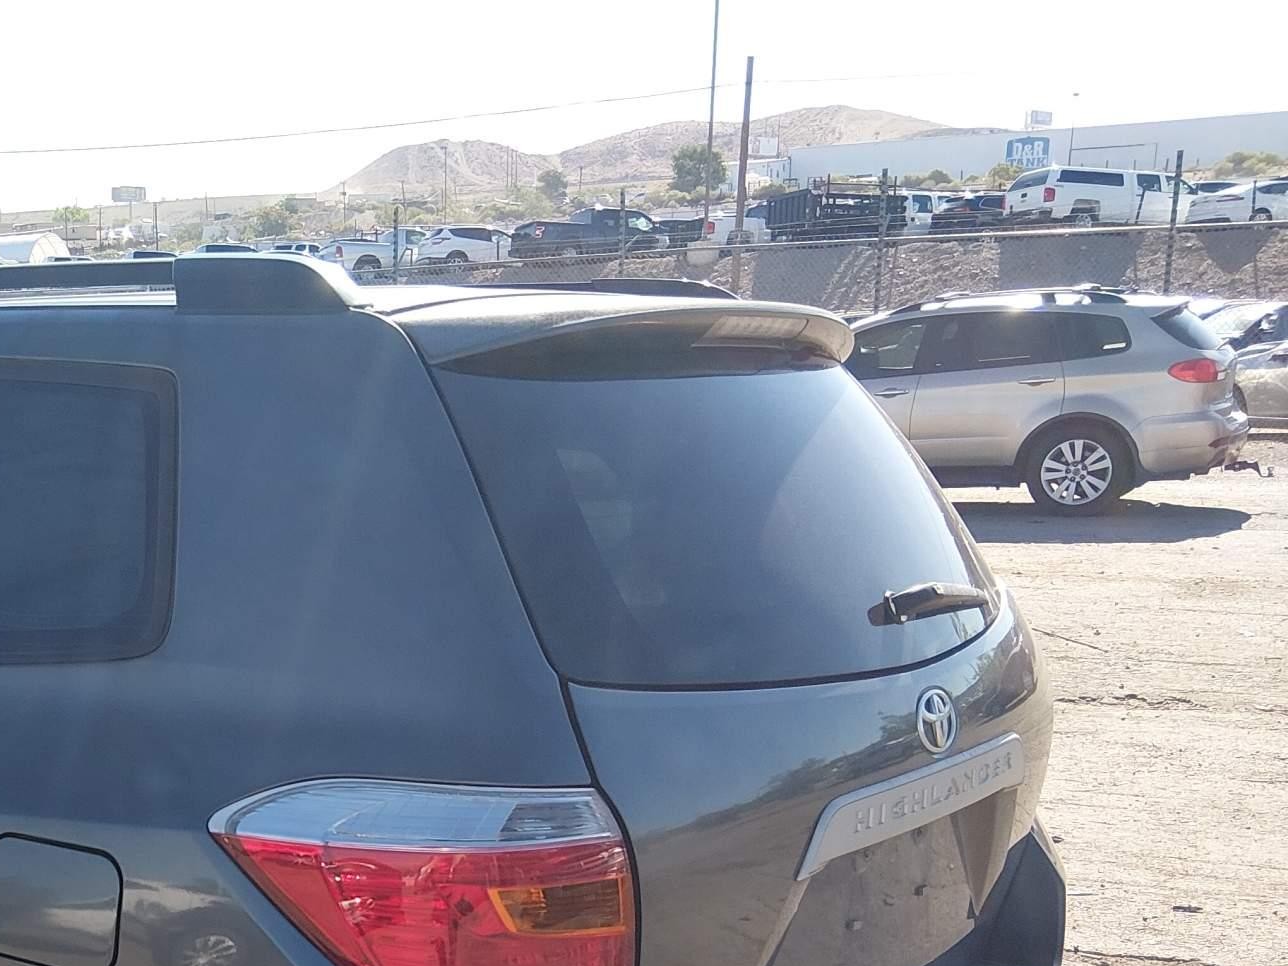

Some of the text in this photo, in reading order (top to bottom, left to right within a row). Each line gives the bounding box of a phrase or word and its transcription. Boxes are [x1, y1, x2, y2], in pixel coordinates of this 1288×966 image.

[1012, 141, 1044, 157] D&R
[1007, 157, 1046, 168] TANK
[854, 751, 1014, 833] HIGHLANDER
